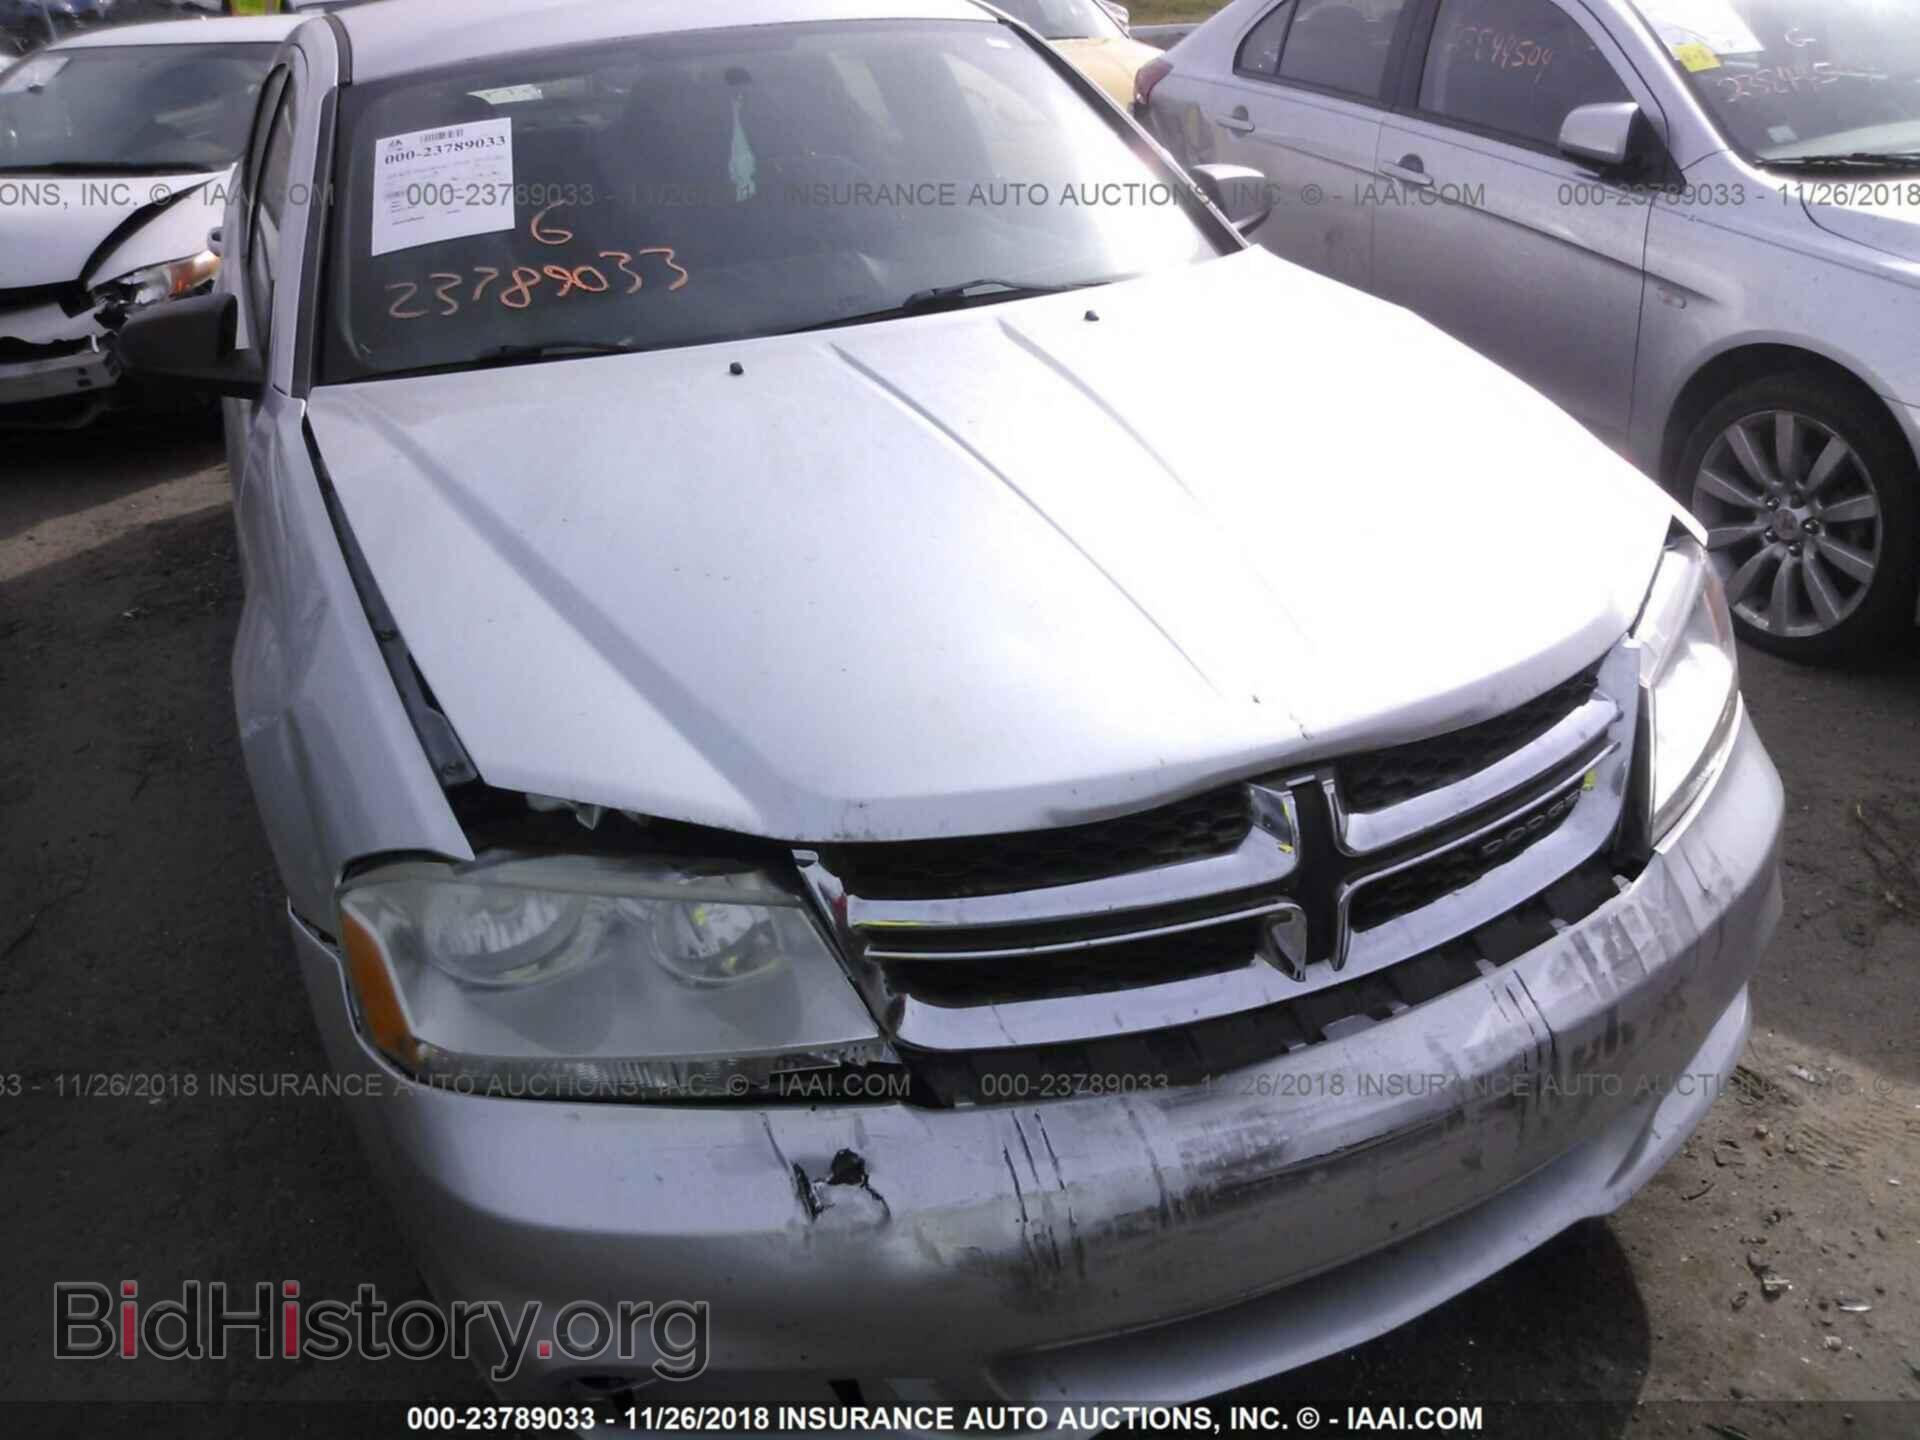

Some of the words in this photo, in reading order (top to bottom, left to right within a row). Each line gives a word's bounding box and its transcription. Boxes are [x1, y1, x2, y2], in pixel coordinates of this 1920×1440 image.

[384, 135, 506, 165] 000-23789033
[384, 248, 689, 319] 23789033
[1481, 788, 1581, 854] DODGE
